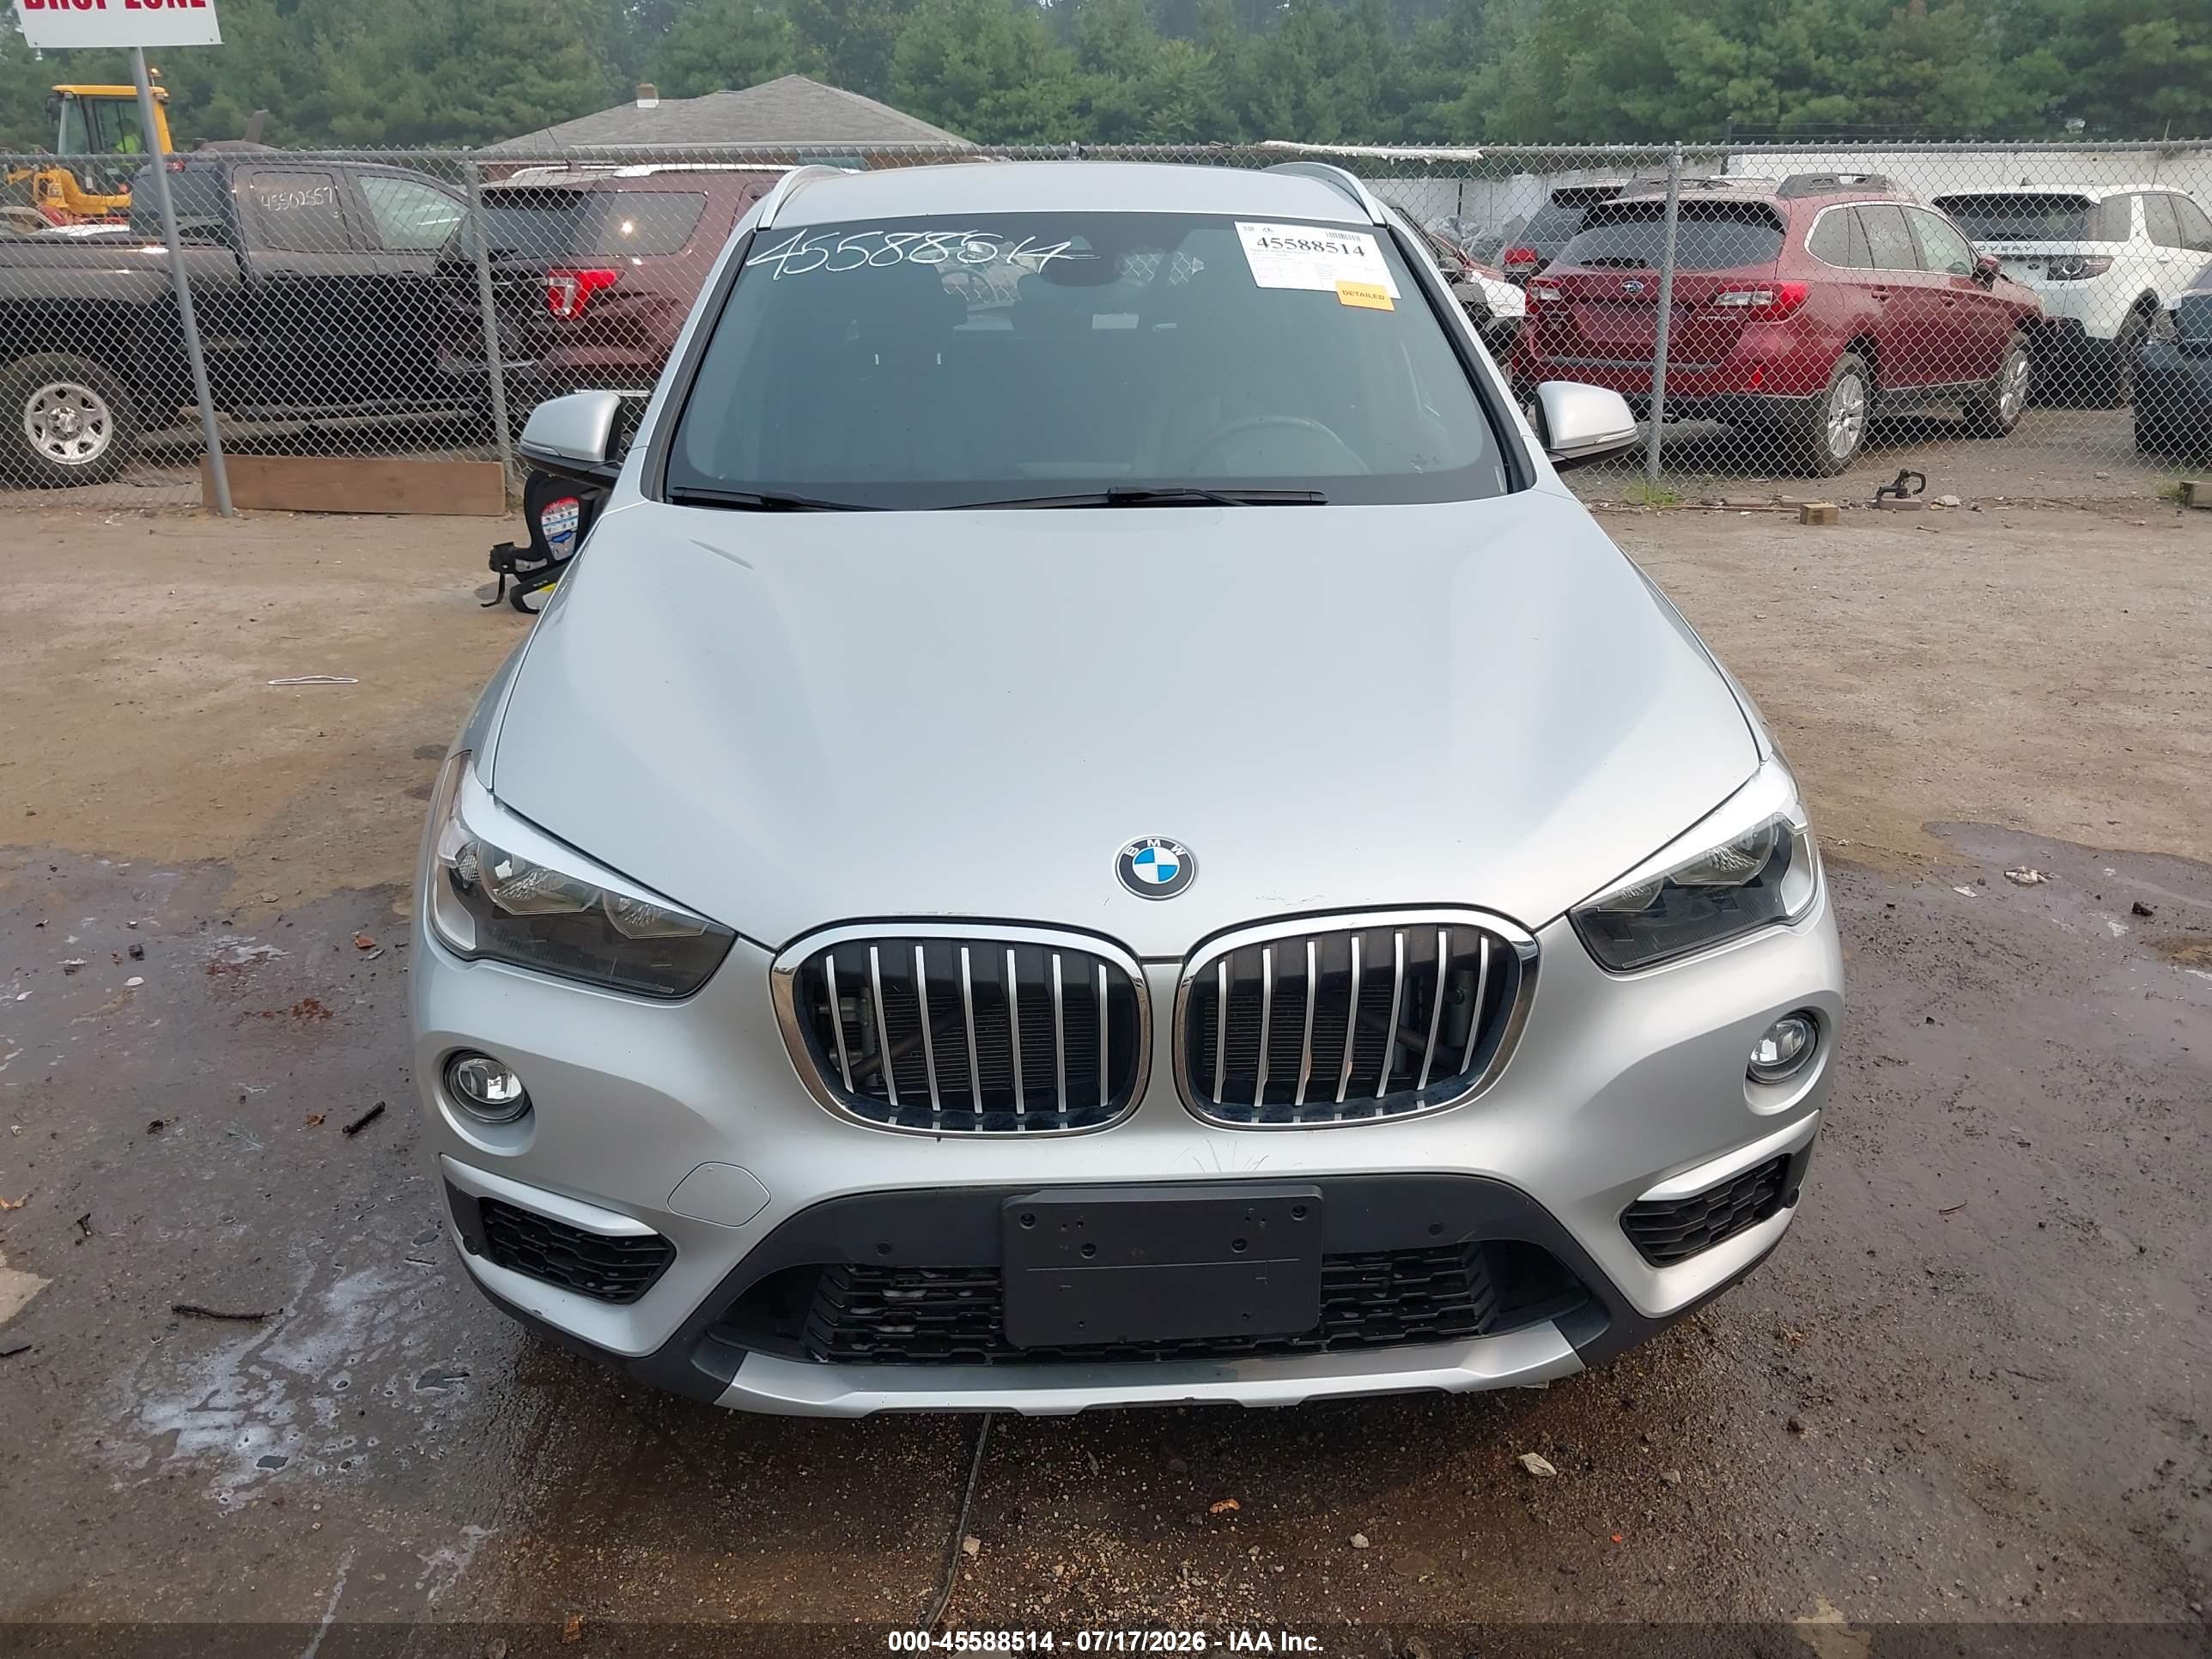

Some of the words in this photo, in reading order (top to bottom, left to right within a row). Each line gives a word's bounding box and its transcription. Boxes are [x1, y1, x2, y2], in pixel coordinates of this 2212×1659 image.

[745, 228, 1101, 281] 45588514
[1256, 236, 1365, 257] 45588514
[1341, 289, 1386, 301] DETAILED
[1125, 839, 1187, 857] BMW
